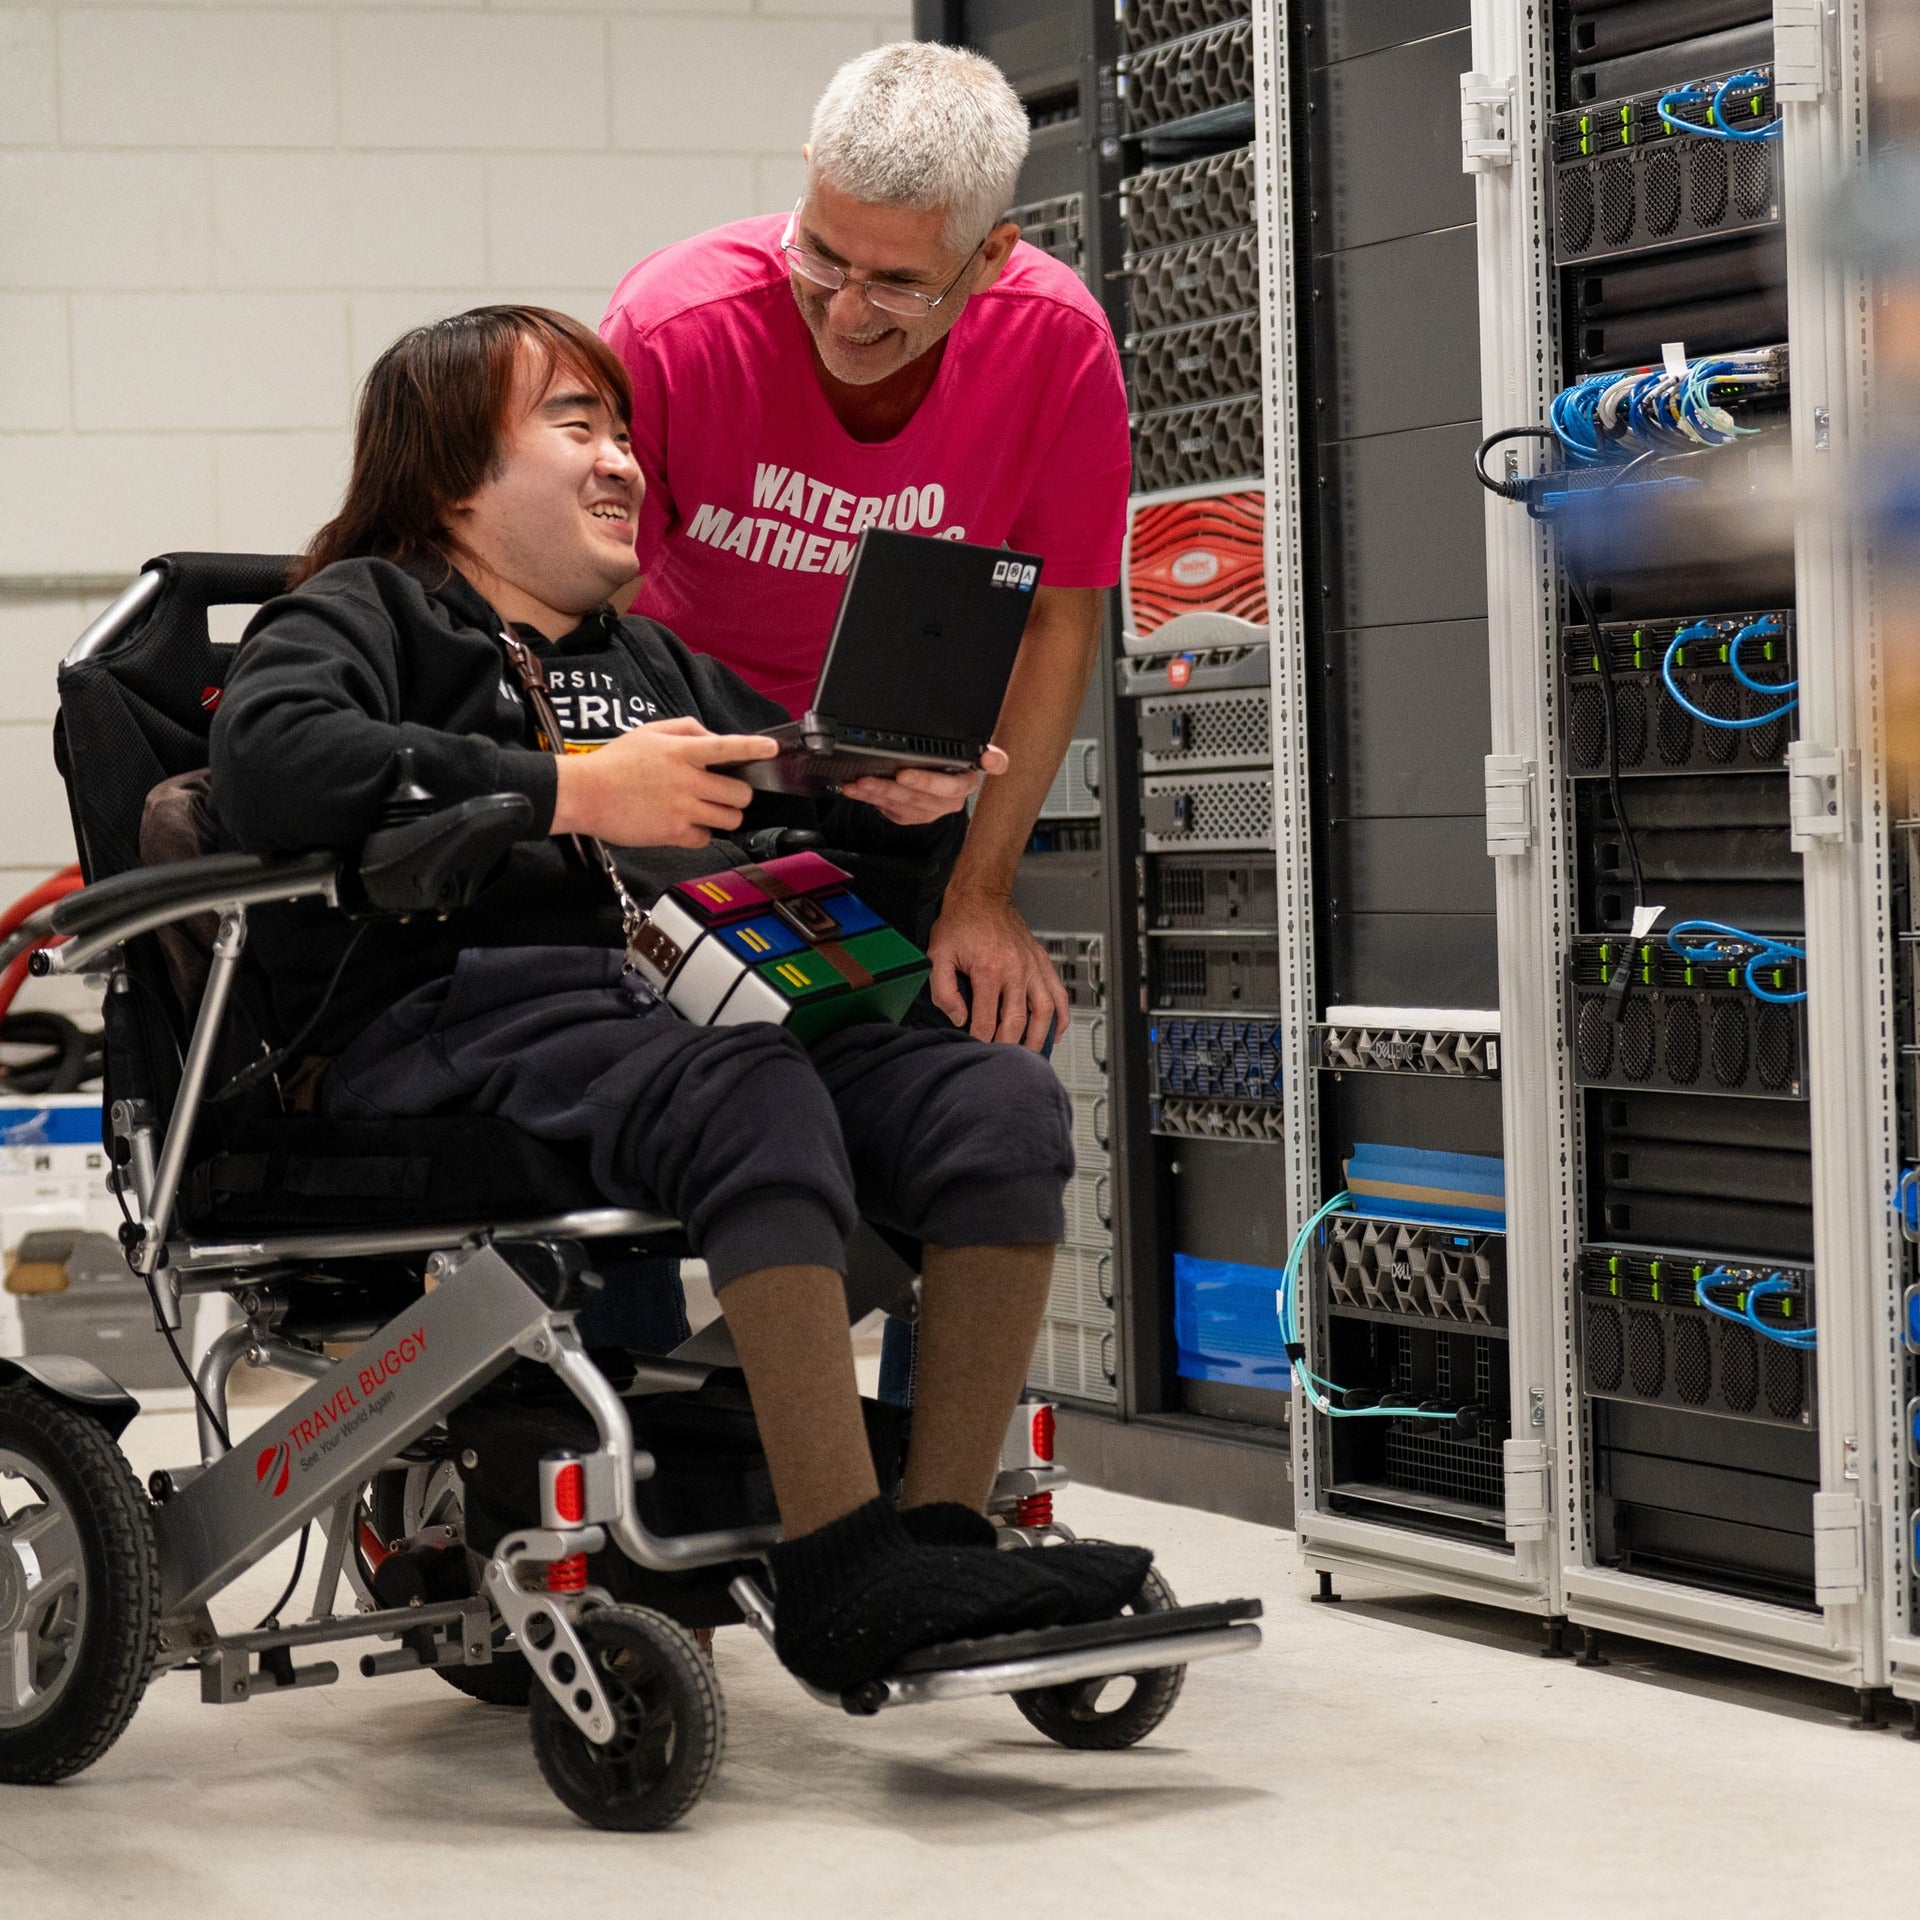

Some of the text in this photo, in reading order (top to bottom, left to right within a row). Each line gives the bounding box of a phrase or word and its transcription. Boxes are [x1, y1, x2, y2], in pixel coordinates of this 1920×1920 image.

[753, 462, 945, 535] WATERLOO
[629, 695, 657, 717] OF
[1391, 1262, 1412, 1281] DELL
[289, 1325, 427, 1451] TRAVEL BUGGY
[300, 1389, 395, 1473] See Your World Again
